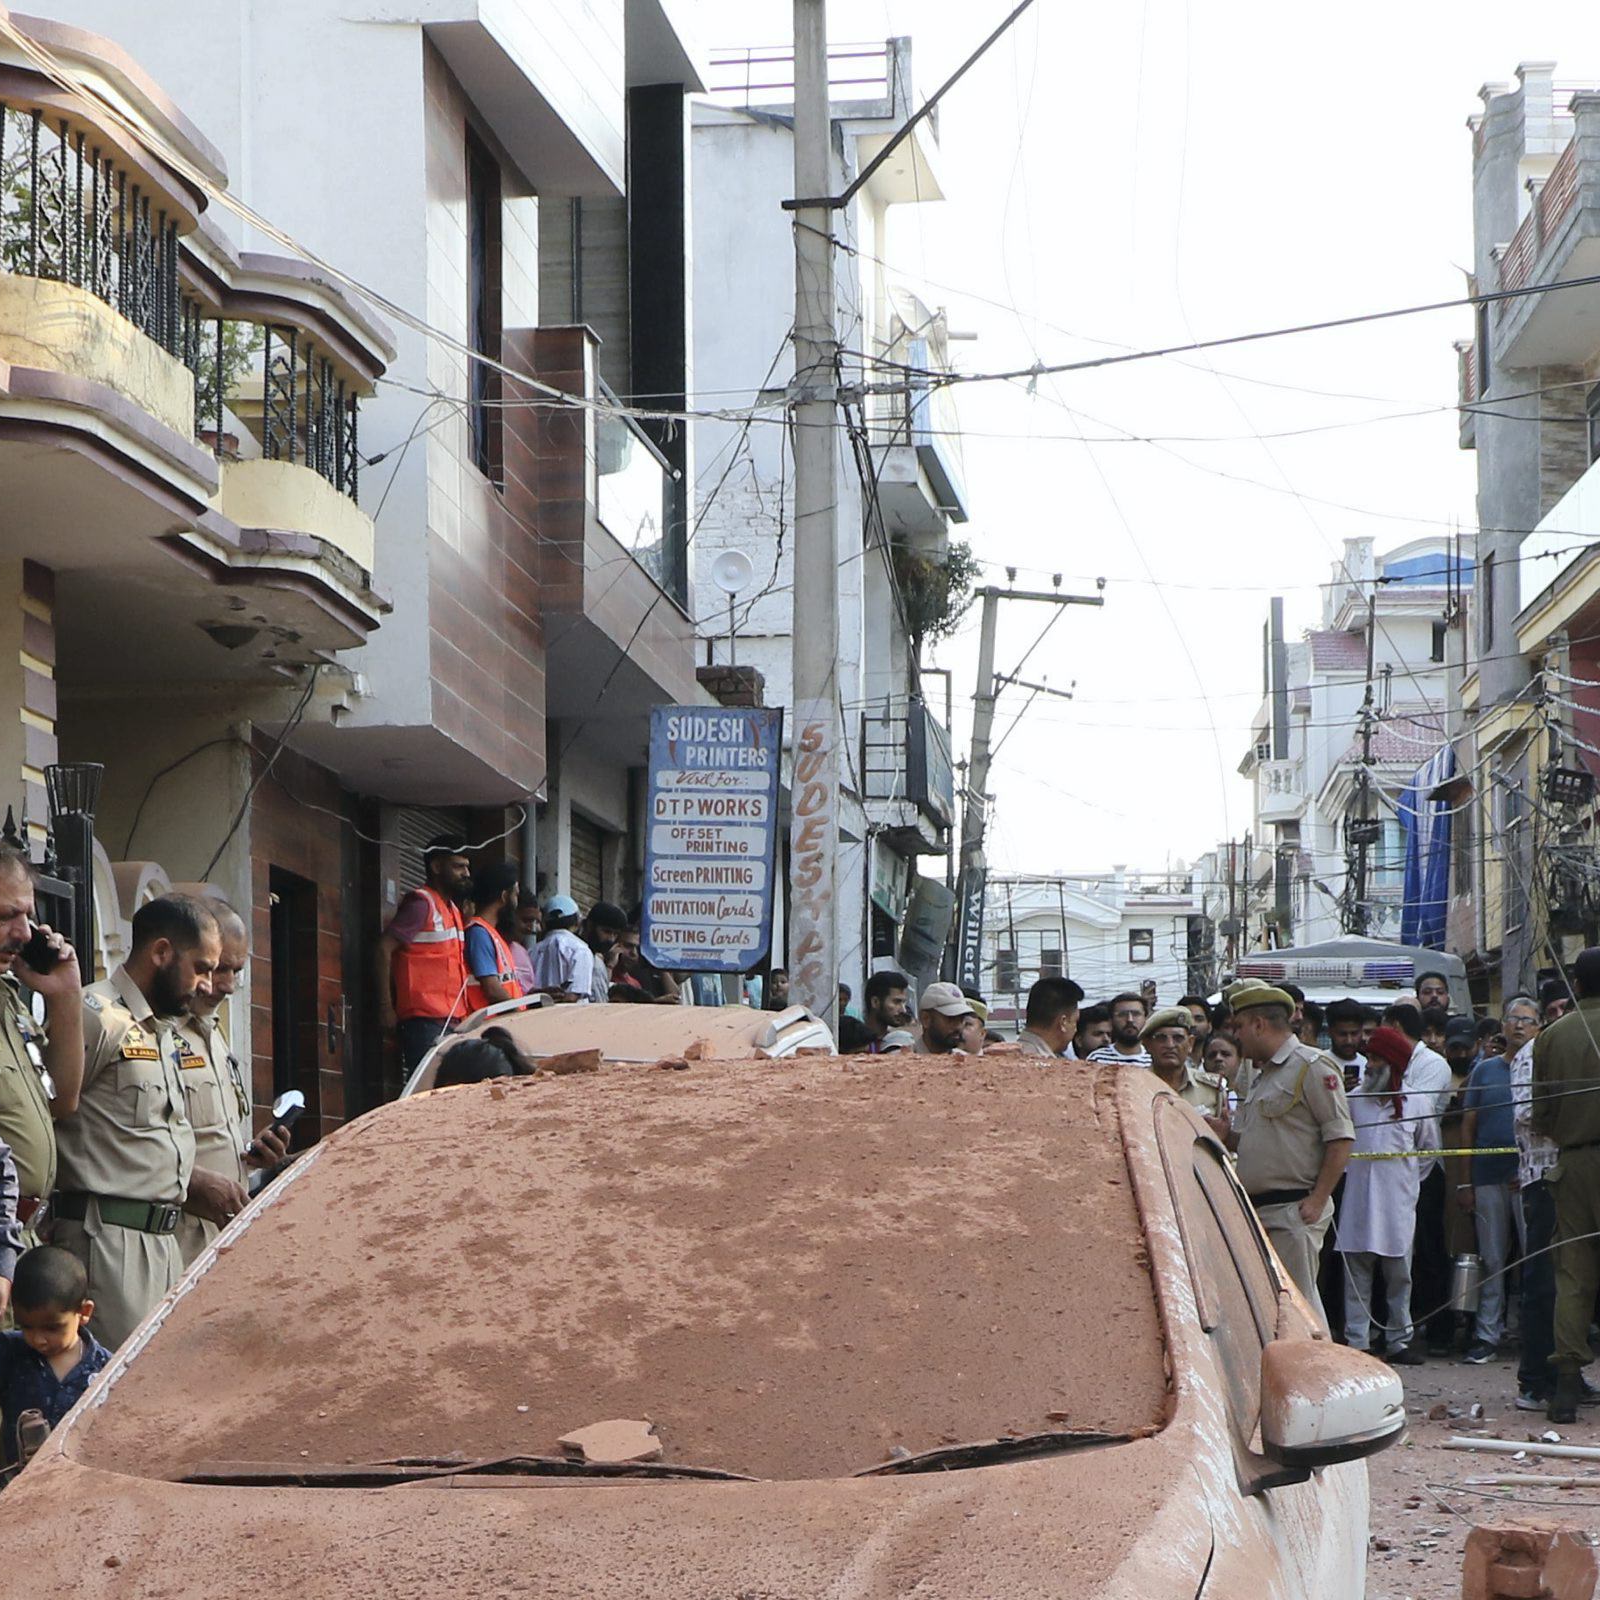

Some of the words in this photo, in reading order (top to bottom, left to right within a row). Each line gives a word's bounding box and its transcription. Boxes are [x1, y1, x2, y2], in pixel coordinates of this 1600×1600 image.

[666, 716, 744, 742] SUDESH
[685, 746, 768, 767] PRINTERS
[697, 799, 761, 816] WORKS
[686, 841, 749, 853] PRINTING
[653, 866, 694, 883] Screen
[695, 867, 753, 884] PRINTING
[651, 899, 716, 915] INVITATION
[716, 896, 755, 920] Cards
[651, 929, 707, 944] VISTING
[711, 928, 751, 946] Cards
[963, 890, 982, 985] Willett
